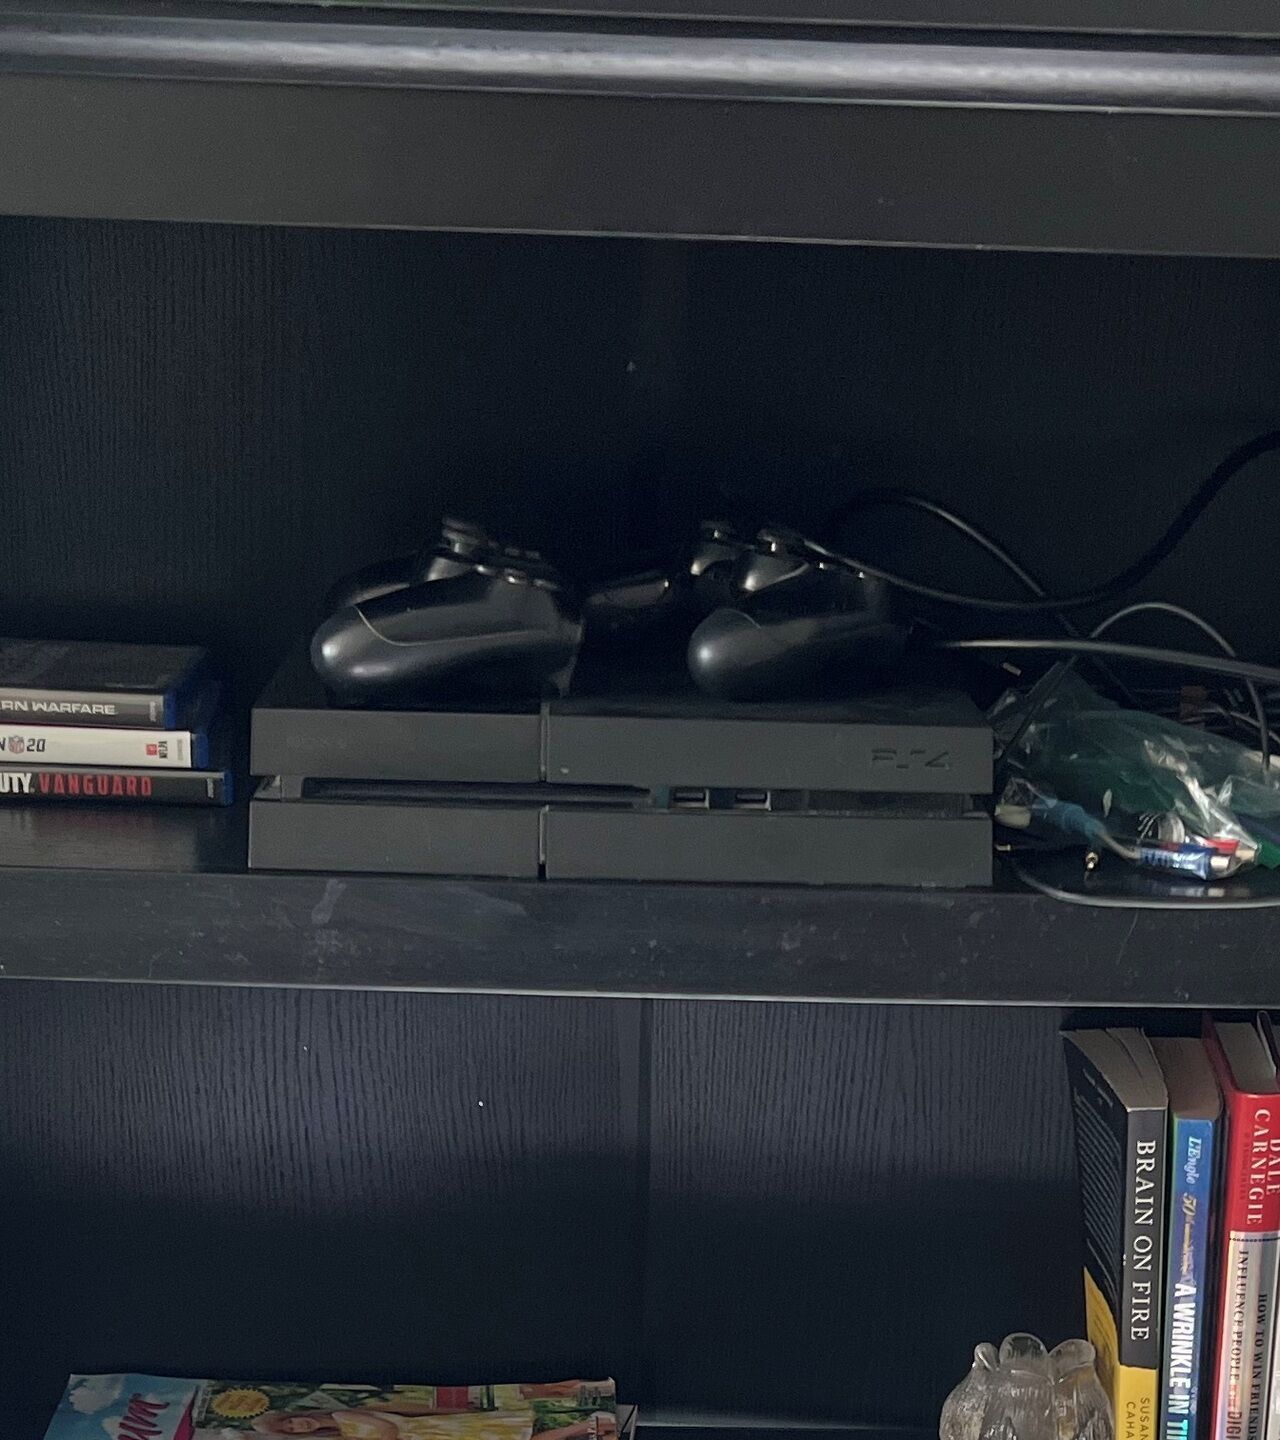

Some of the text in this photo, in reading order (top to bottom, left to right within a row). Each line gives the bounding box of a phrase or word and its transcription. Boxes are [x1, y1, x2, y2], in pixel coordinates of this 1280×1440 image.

[31, 700, 117, 716] WARFARE
[26, 737, 46, 753] 20
[38, 772, 153, 797] VANGUARD
[1246, 1108, 1271, 1226] CARNEGIE
[1130, 1139, 1157, 1341] BRAIN ON FIRE
[1174, 1282, 1197, 1298] A
[1232, 1250, 1250, 1326] INFLUENCE
[1257, 1293, 1269, 1324] HOW
[1169, 1302, 1197, 1389] WRINKLE
[1255, 1328, 1266, 1347] TO
[1229, 1328, 1245, 1381] PEOPLE
[1253, 1351, 1264, 1381] WIN
[1167, 1394, 1191, 1415] IN
